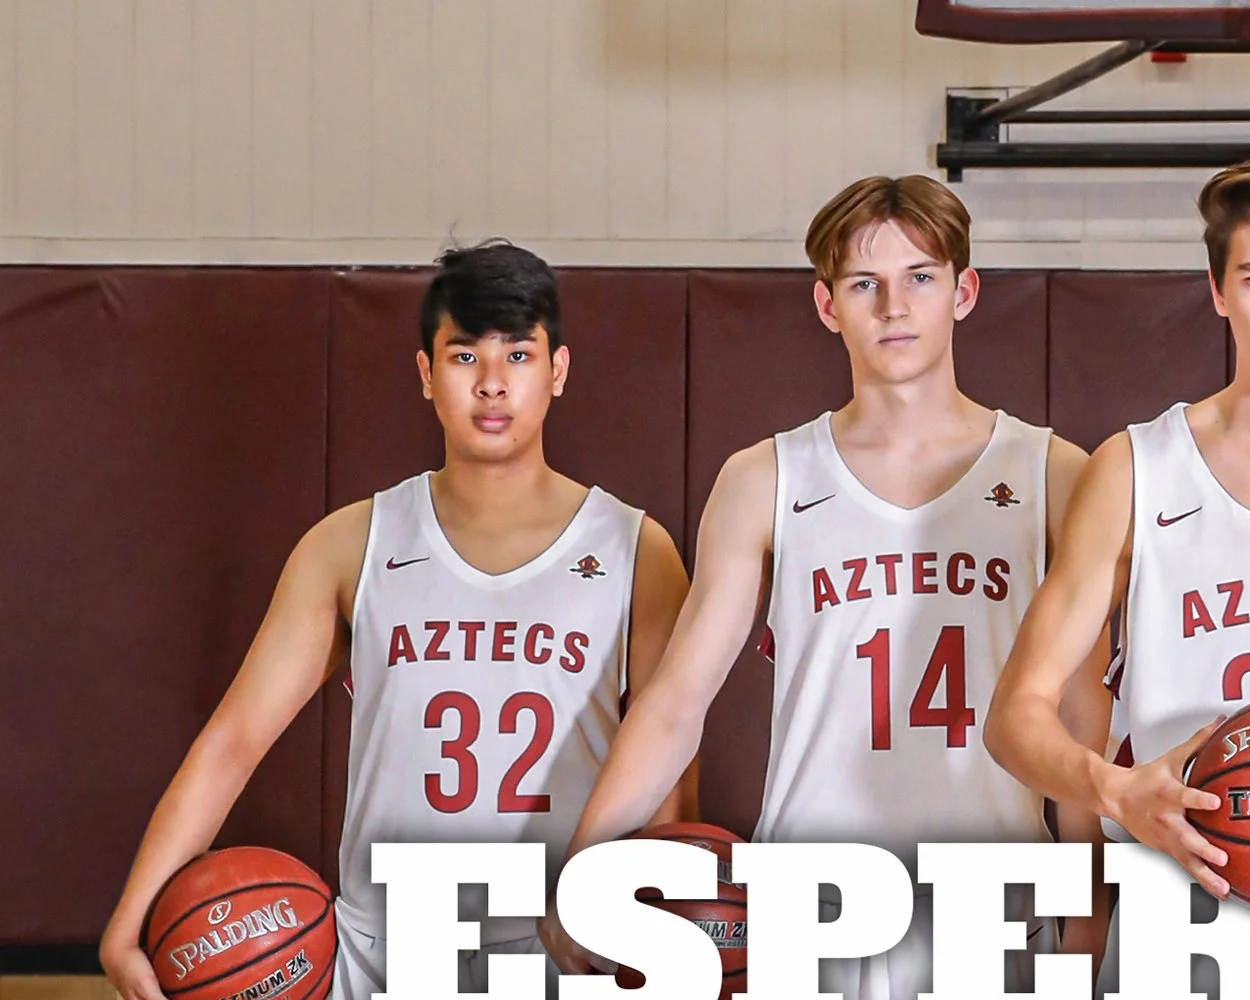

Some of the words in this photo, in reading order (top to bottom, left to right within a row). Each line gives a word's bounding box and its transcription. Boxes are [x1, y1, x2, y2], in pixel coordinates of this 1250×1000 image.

[811, 551, 1011, 614] AZTECS
[387, 620, 590, 674] AZTECS
[855, 624, 976, 751] 14
[423, 690, 555, 814] 32
[168, 896, 298, 981] SPALDING
[285, 949, 308, 978] ZK
